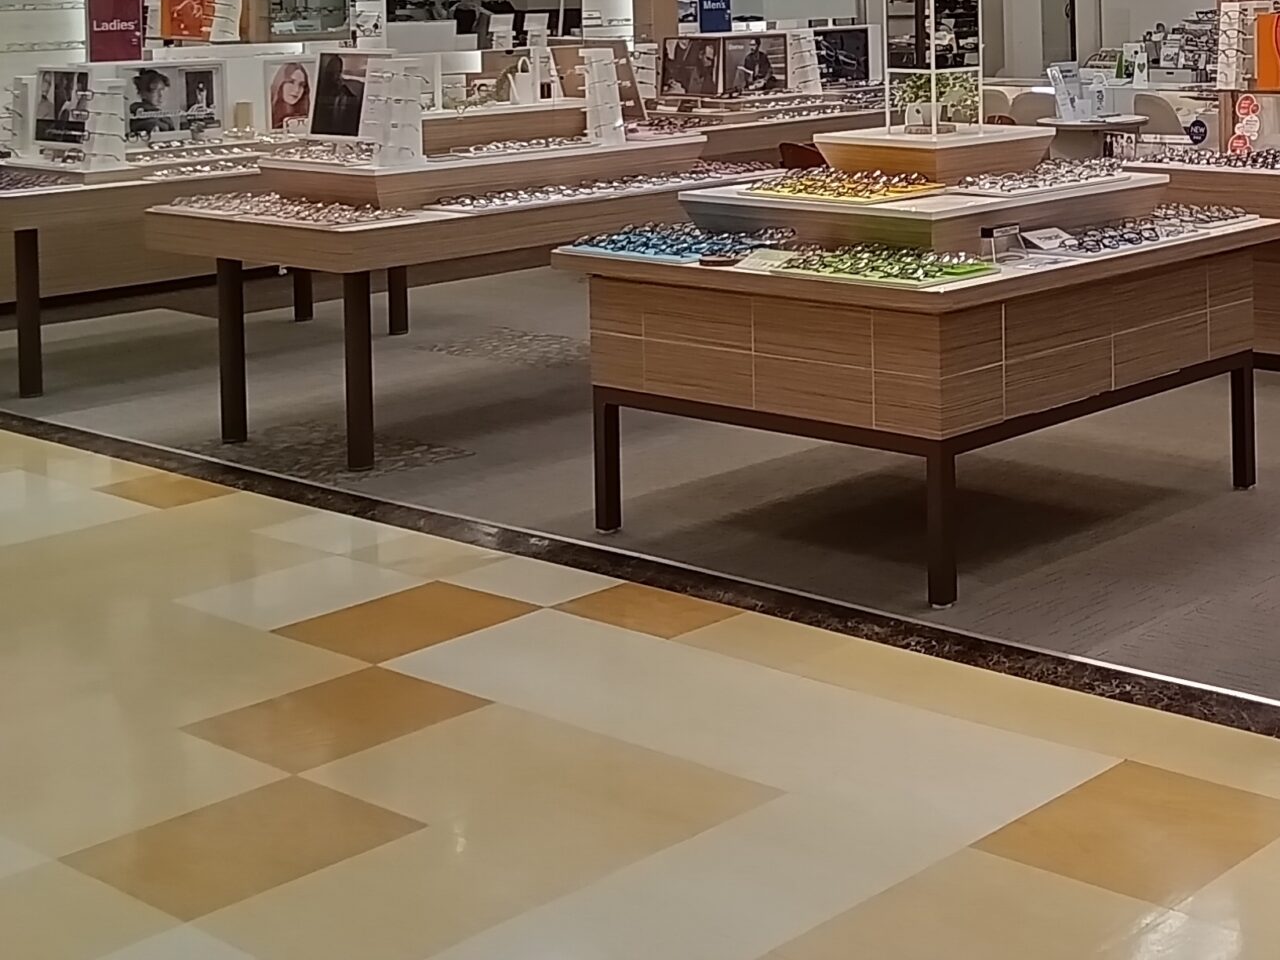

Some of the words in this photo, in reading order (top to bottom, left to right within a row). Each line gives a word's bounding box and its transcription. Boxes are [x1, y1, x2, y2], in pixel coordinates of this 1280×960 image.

[703, 0, 726, 10] Men's
[92, 19, 139, 32] Ladies'
[1190, 125, 1206, 134] NEW
